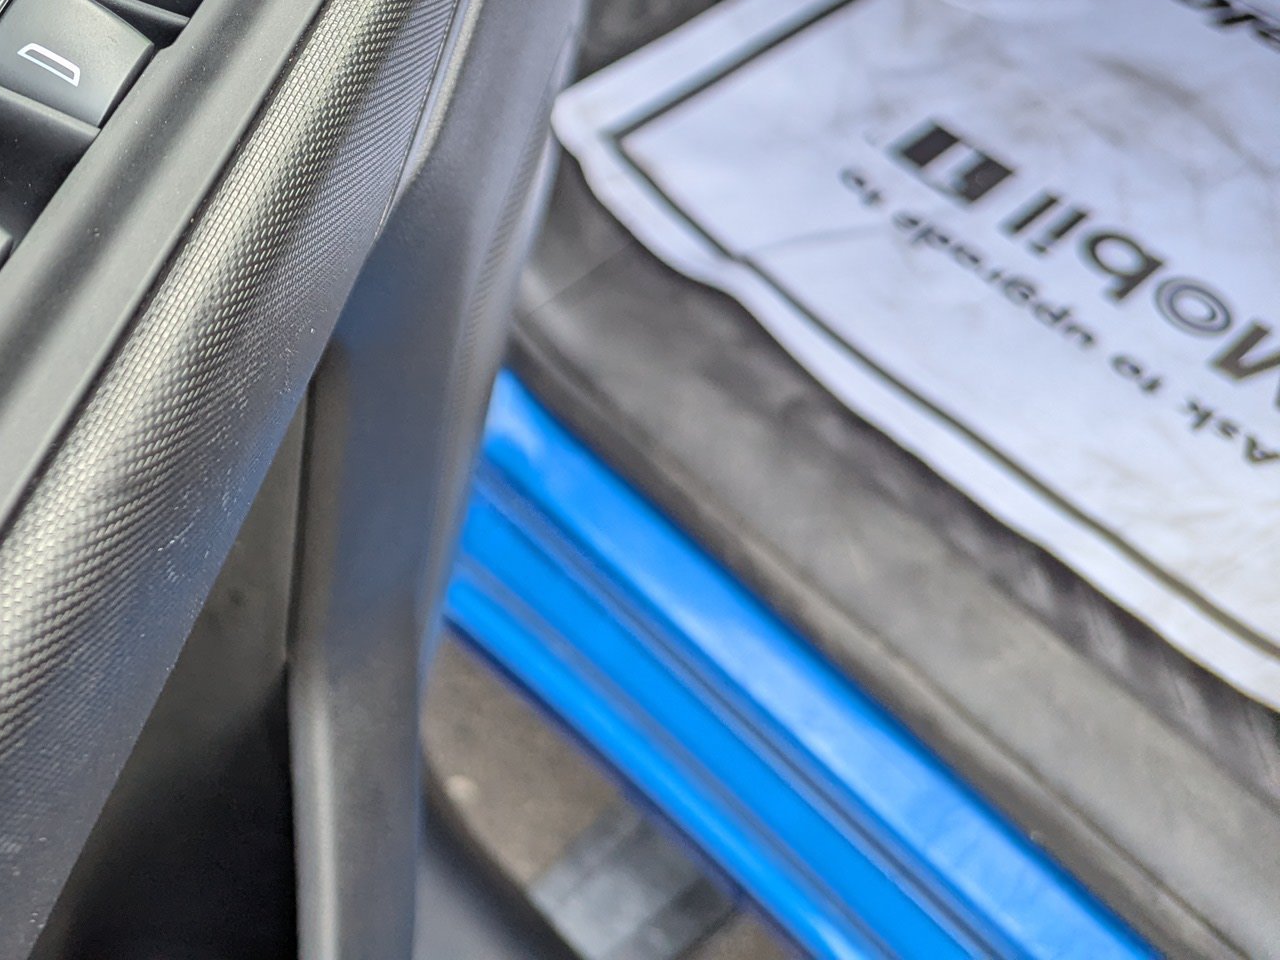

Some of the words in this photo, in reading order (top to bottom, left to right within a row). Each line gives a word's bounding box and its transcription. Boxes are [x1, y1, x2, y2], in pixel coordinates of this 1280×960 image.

[839, 167, 885, 207] to
[890, 120, 1014, 208] 1
[893, 212, 1096, 349] upgrade
[1000, 191, 1280, 412] Mobil
[1110, 355, 1163, 395] to
[1184, 397, 1280, 464] Ask
